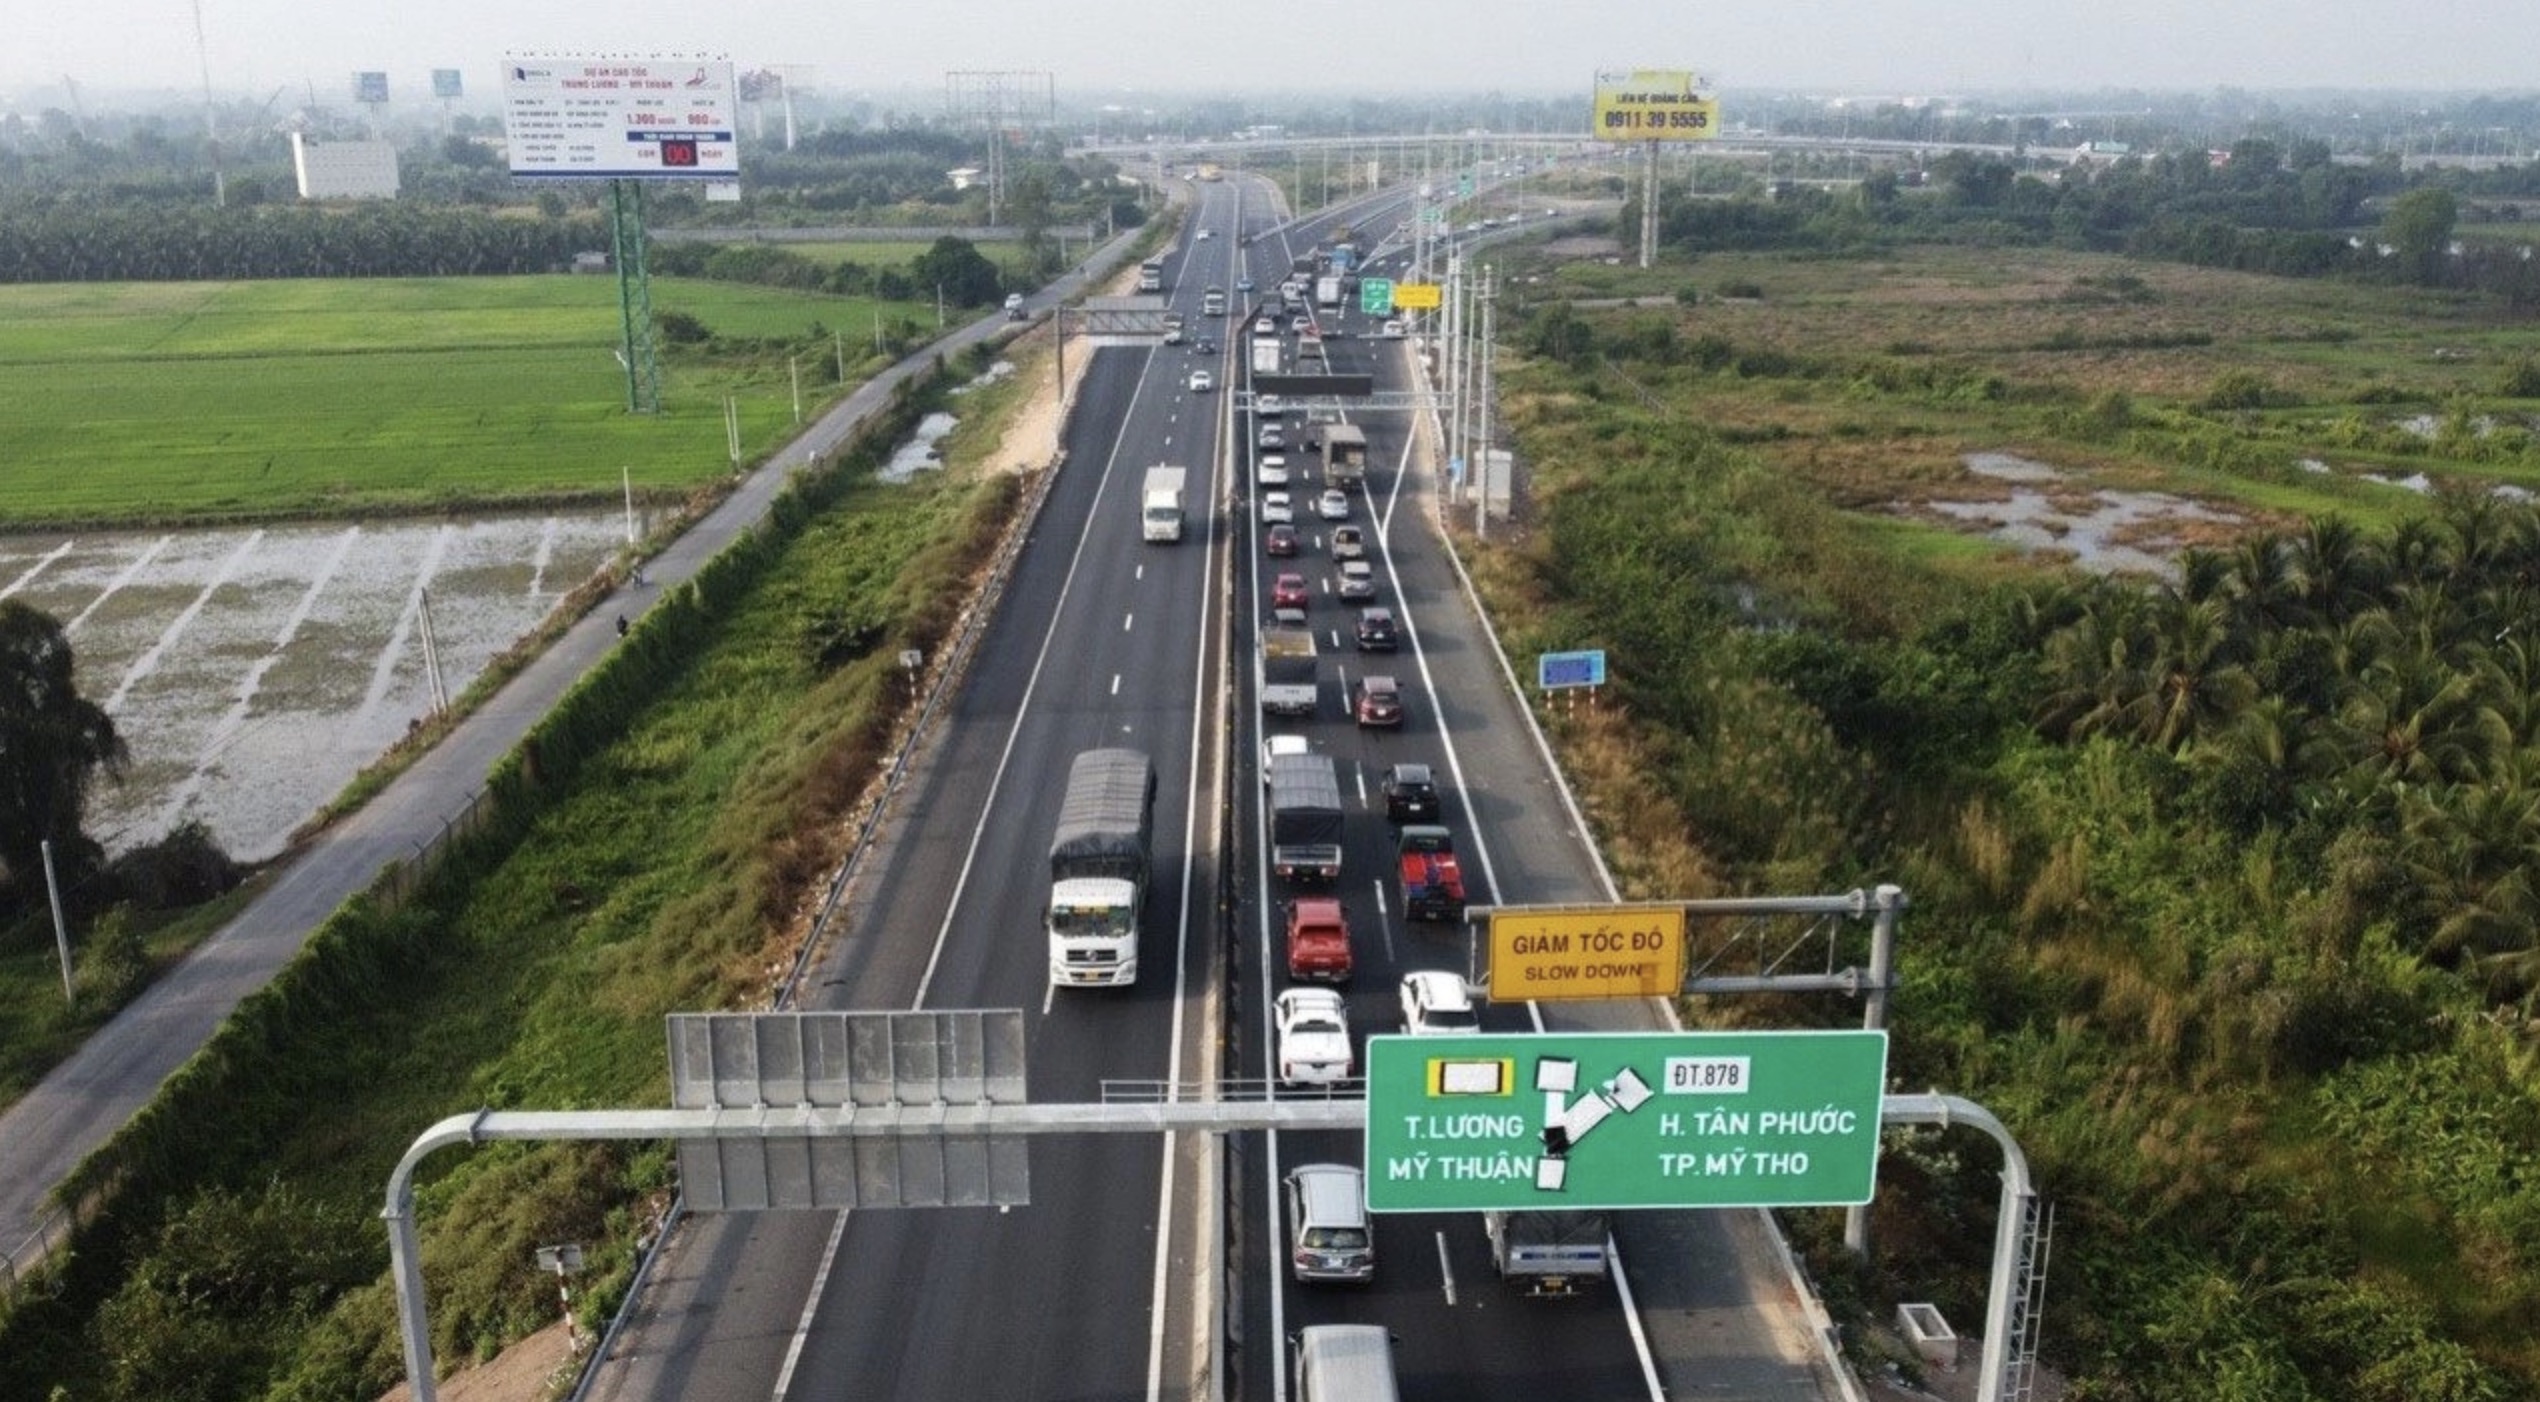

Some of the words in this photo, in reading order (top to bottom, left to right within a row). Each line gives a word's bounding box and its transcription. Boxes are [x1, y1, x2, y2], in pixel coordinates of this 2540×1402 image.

[1605, 111, 1642, 129] 0911
[1646, 111, 1667, 129] 39
[1670, 111, 1708, 129] 5555
[1512, 927, 1570, 955] GIẢM
[1579, 925, 1625, 952] TỐC
[1631, 925, 1664, 955] ĐỘ
[1524, 965, 1580, 981] SLOW
[1585, 963, 1643, 979] DOWN
[1673, 1063, 1740, 1087] ĐT.878
[1404, 1112, 1526, 1139] T.LƯƠNG
[1659, 1112, 1687, 1136] H.
[1693, 1106, 1750, 1136] TÂN
[1758, 1103, 1858, 1136] PHƯỚC
[1388, 1151, 1431, 1181] MỸ
[1437, 1150, 1534, 1185] THUẬN
[1752, 1152, 1810, 1176] THO
